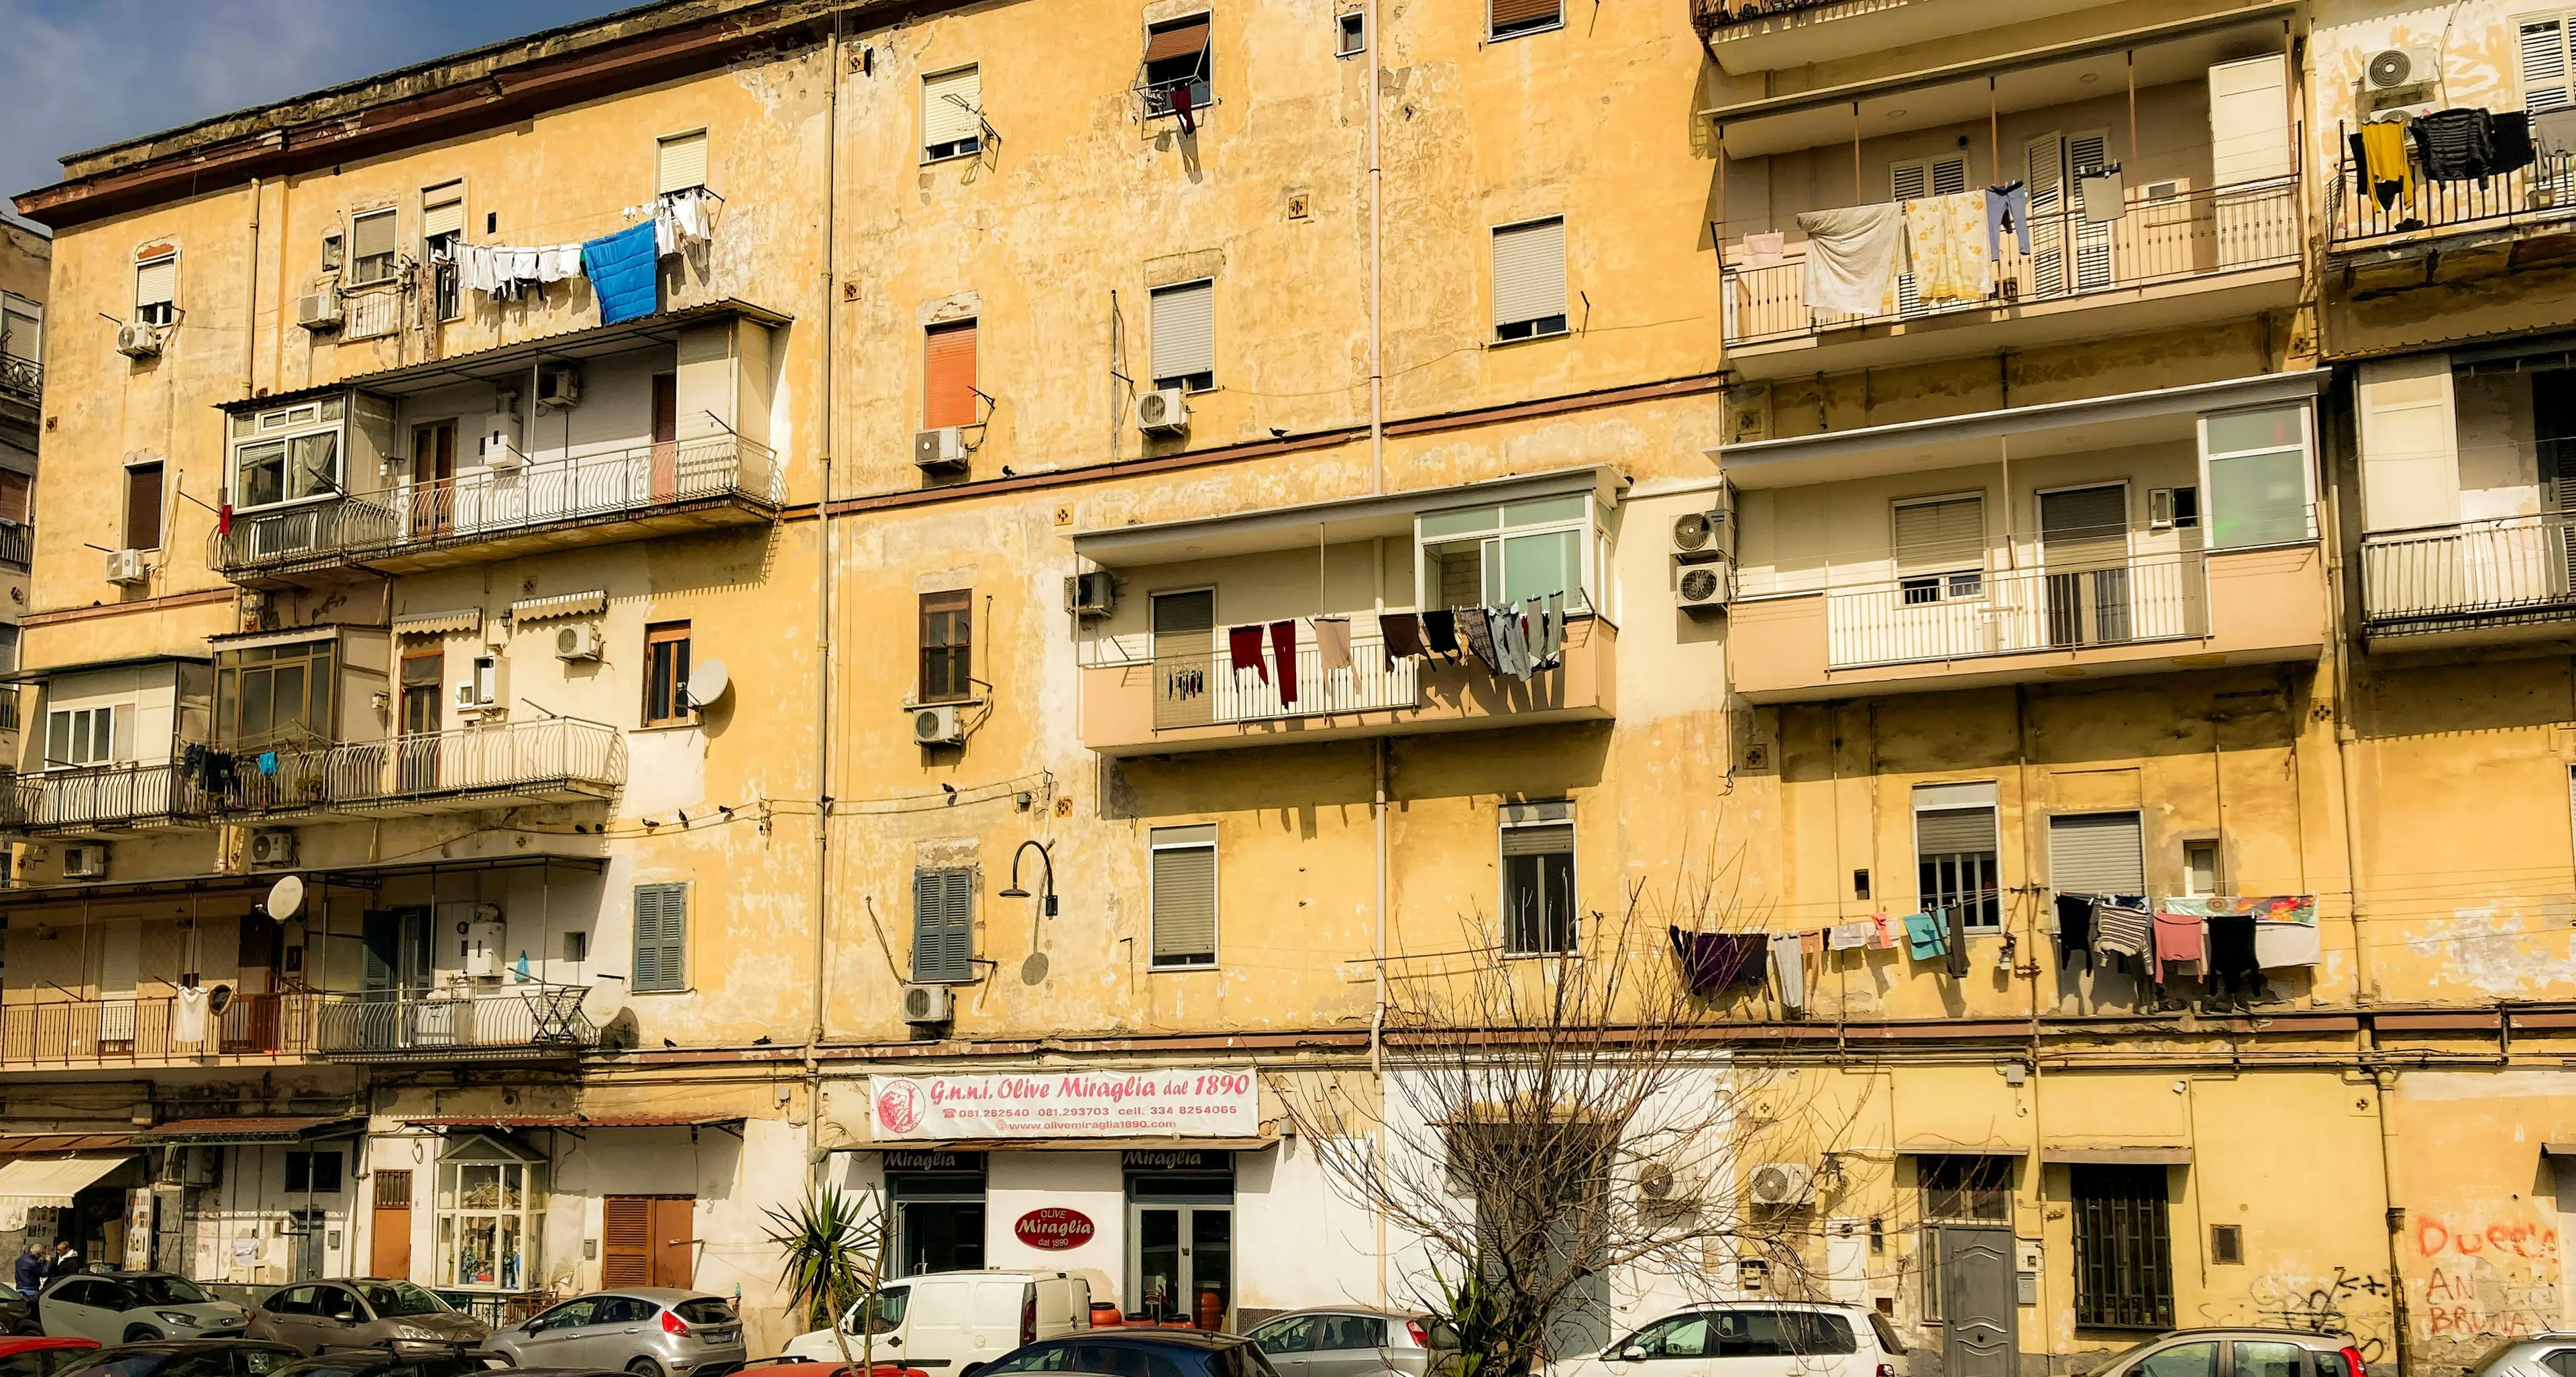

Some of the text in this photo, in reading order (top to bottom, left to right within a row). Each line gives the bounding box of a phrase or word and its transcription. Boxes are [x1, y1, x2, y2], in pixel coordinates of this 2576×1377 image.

[930, 1074, 1250, 1105] G.n.n.i. Olive Miraglia dal 1890
[959, 1105, 1237, 1118] 081.282540 081.293703 cell. 334 8254065
[1009, 1120, 1177, 1131] www.olivemiraglia1890.com
[884, 1150, 955, 1170] Miraglia
[1123, 1150, 1201, 1169] Miraglia
[1040, 1209, 1067, 1219] OLIVE
[1018, 1219, 1091, 1237] Miraglia
[1038, 1238, 1068, 1248] dal 1890
